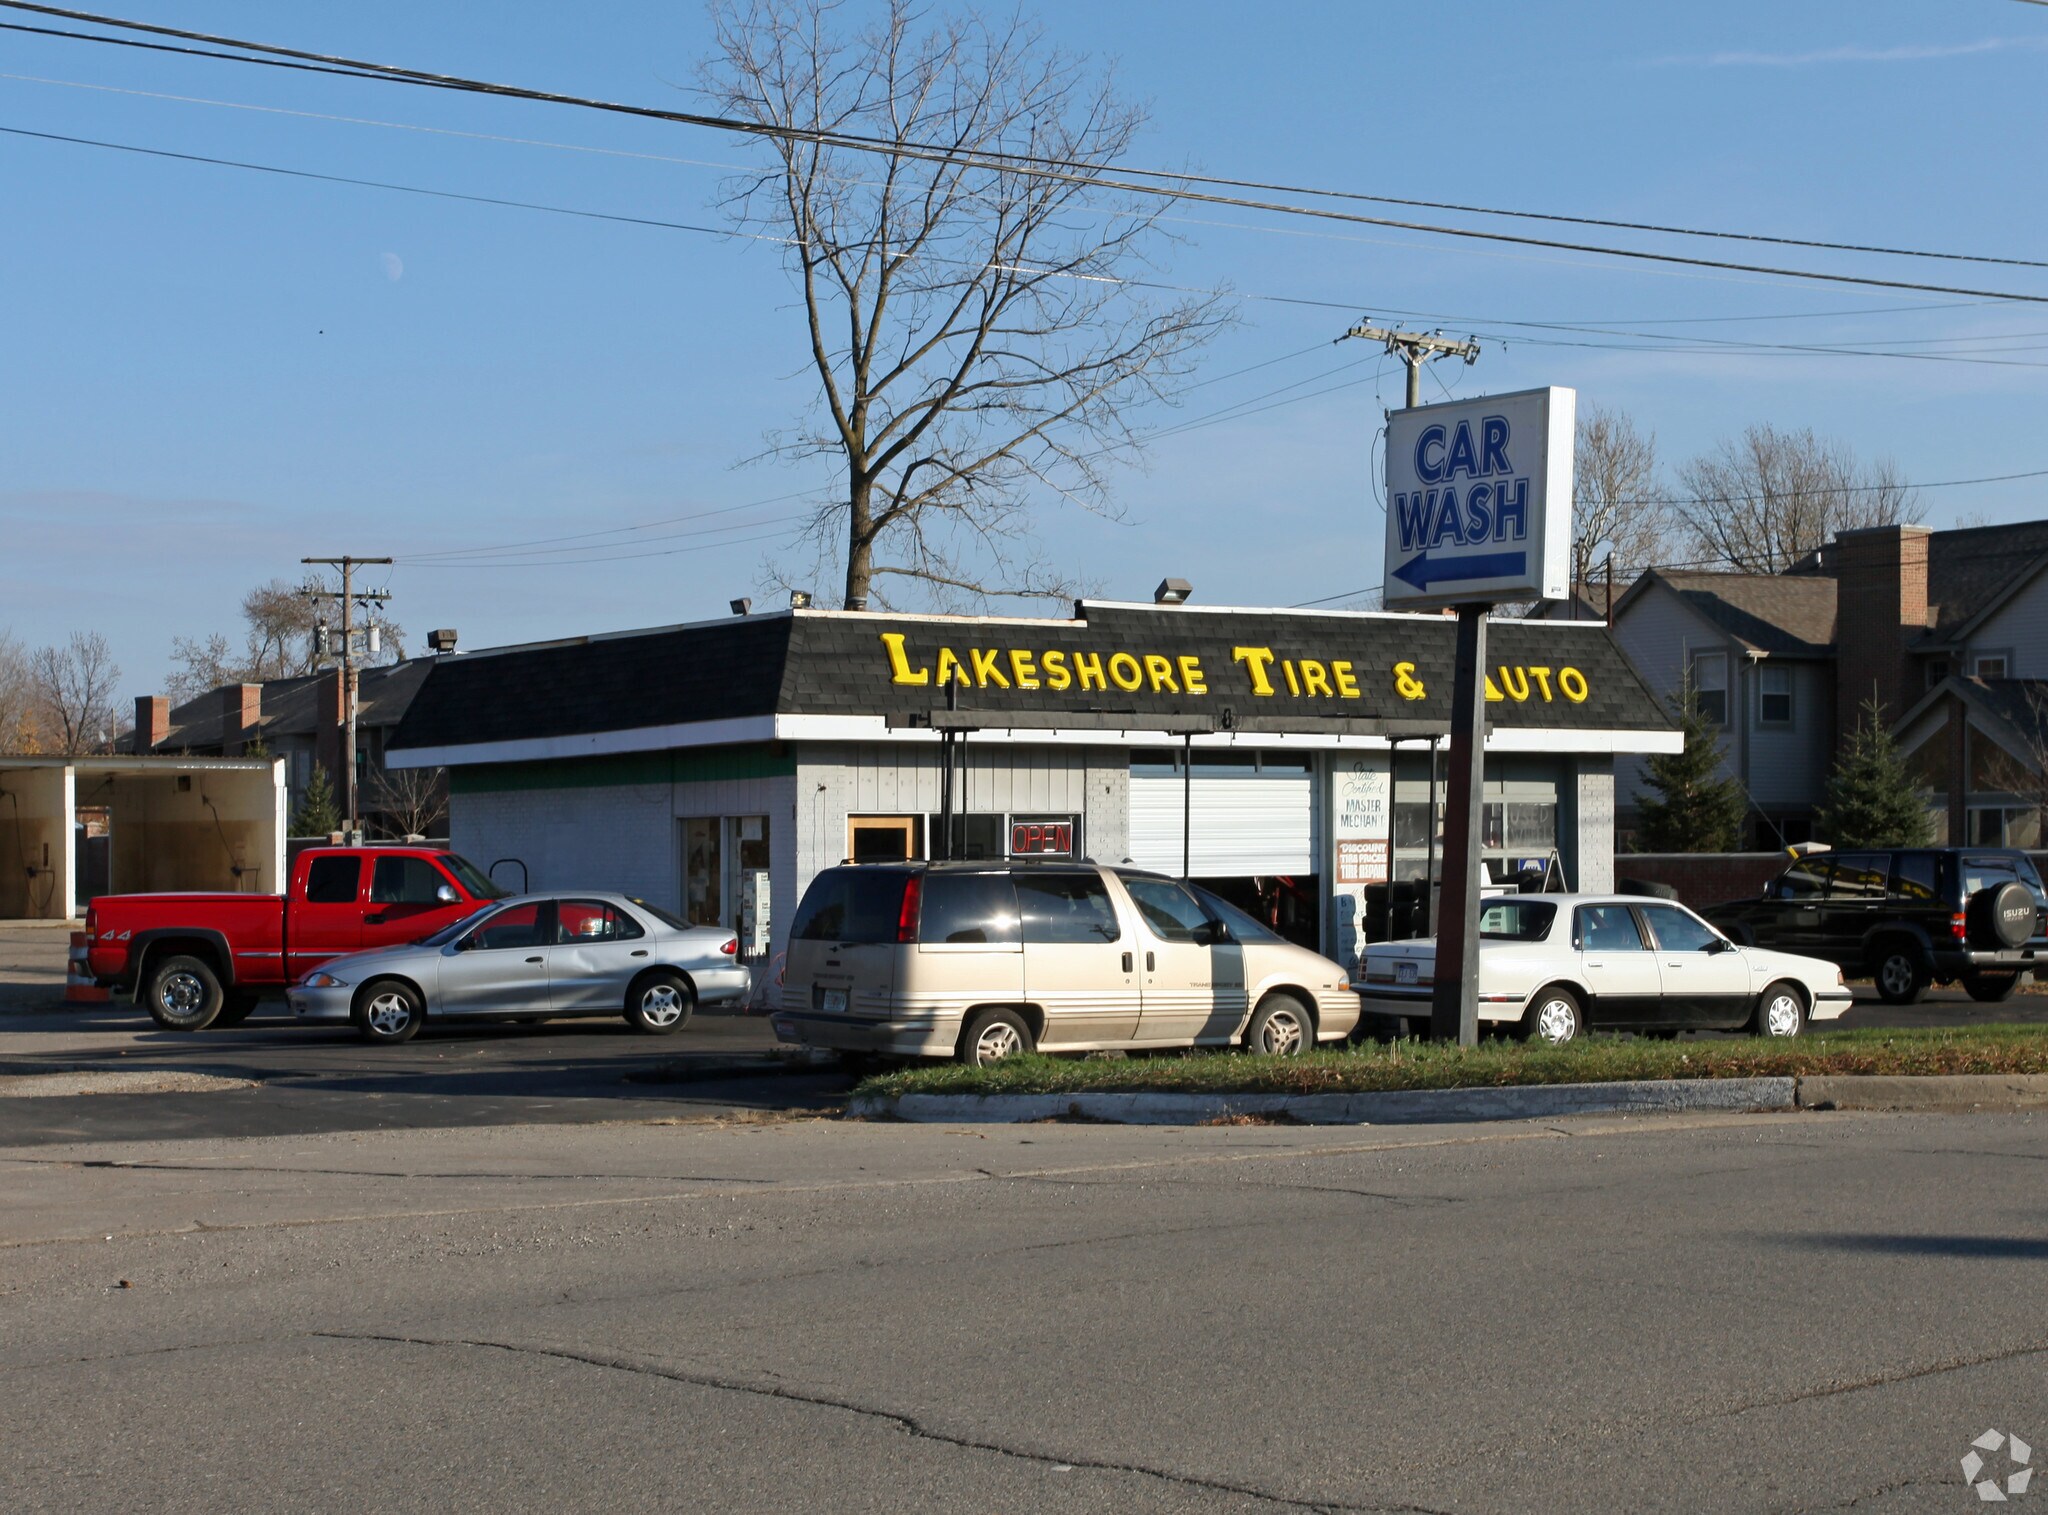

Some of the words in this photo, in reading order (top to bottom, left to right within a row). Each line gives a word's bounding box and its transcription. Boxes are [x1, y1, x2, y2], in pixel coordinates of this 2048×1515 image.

[1414, 415, 1514, 485] CAR
[1395, 477, 1529, 552] WASH
[880, 633, 1208, 695] LAKESHORE
[1232, 646, 1361, 699] TIRE
[1393, 662, 1426, 701] &
[1346, 761, 1378, 781] State
[1341, 781, 1385, 798] Certified
[1346, 799, 1381, 812] MASTER
[1509, 807, 1549, 825] USED
[1013, 825, 1070, 853] OPEN
[1340, 843, 1387, 854] DISCOUNT
[1340, 853, 1358, 863] TIRE
[1359, 853, 1387, 863] PRICES
[1341, 863, 1357, 879] TIRE
[1359, 863, 1387, 879] REPAIR
[2003, 907, 2030, 918] ISUZU
